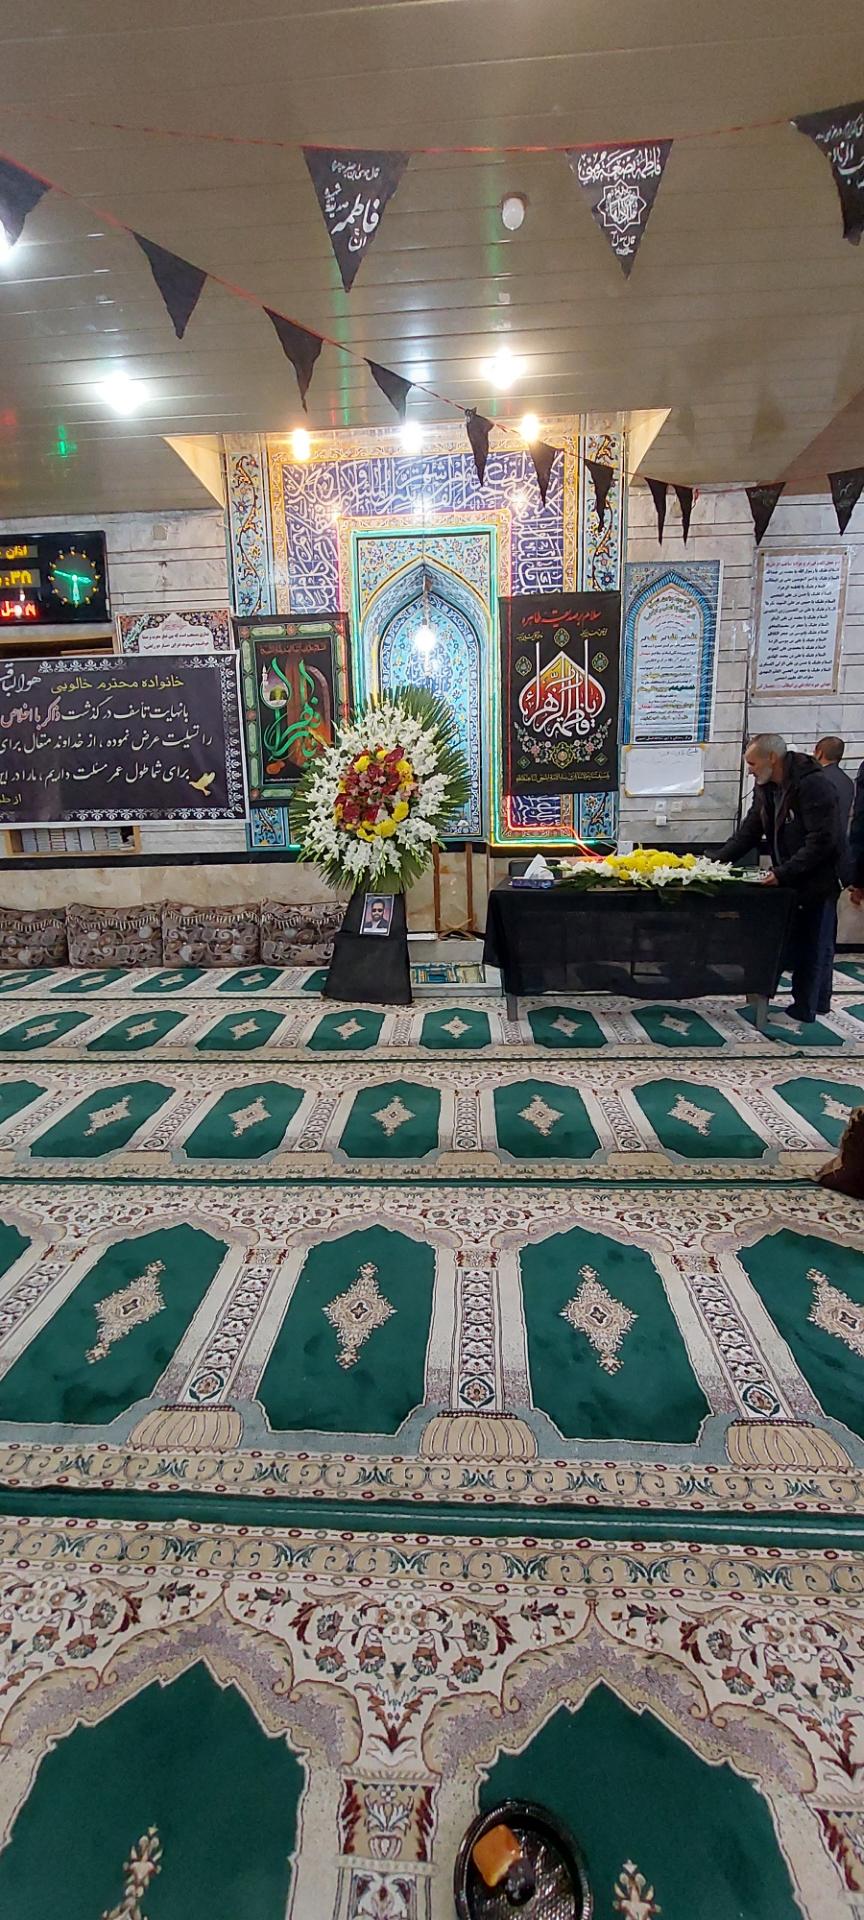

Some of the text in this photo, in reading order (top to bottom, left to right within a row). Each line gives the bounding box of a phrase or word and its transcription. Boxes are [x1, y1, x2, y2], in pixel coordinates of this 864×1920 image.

[97, 677, 138, 691] محترم
[141, 674, 185, 690] خانواده
[23, 732, 52, 754] متعال
[53, 732, 85, 749] خداوند
[86, 731, 97, 748] از
[131, 729, 160, 751] عرض
[161, 724, 200, 749] تسلیت
[202, 733, 213, 746] را
[44, 767, 70, 789] داریم
[106, 764, 124, 783] عمر
[125, 762, 149, 784] طول
[162, 767, 190, 783] برای
